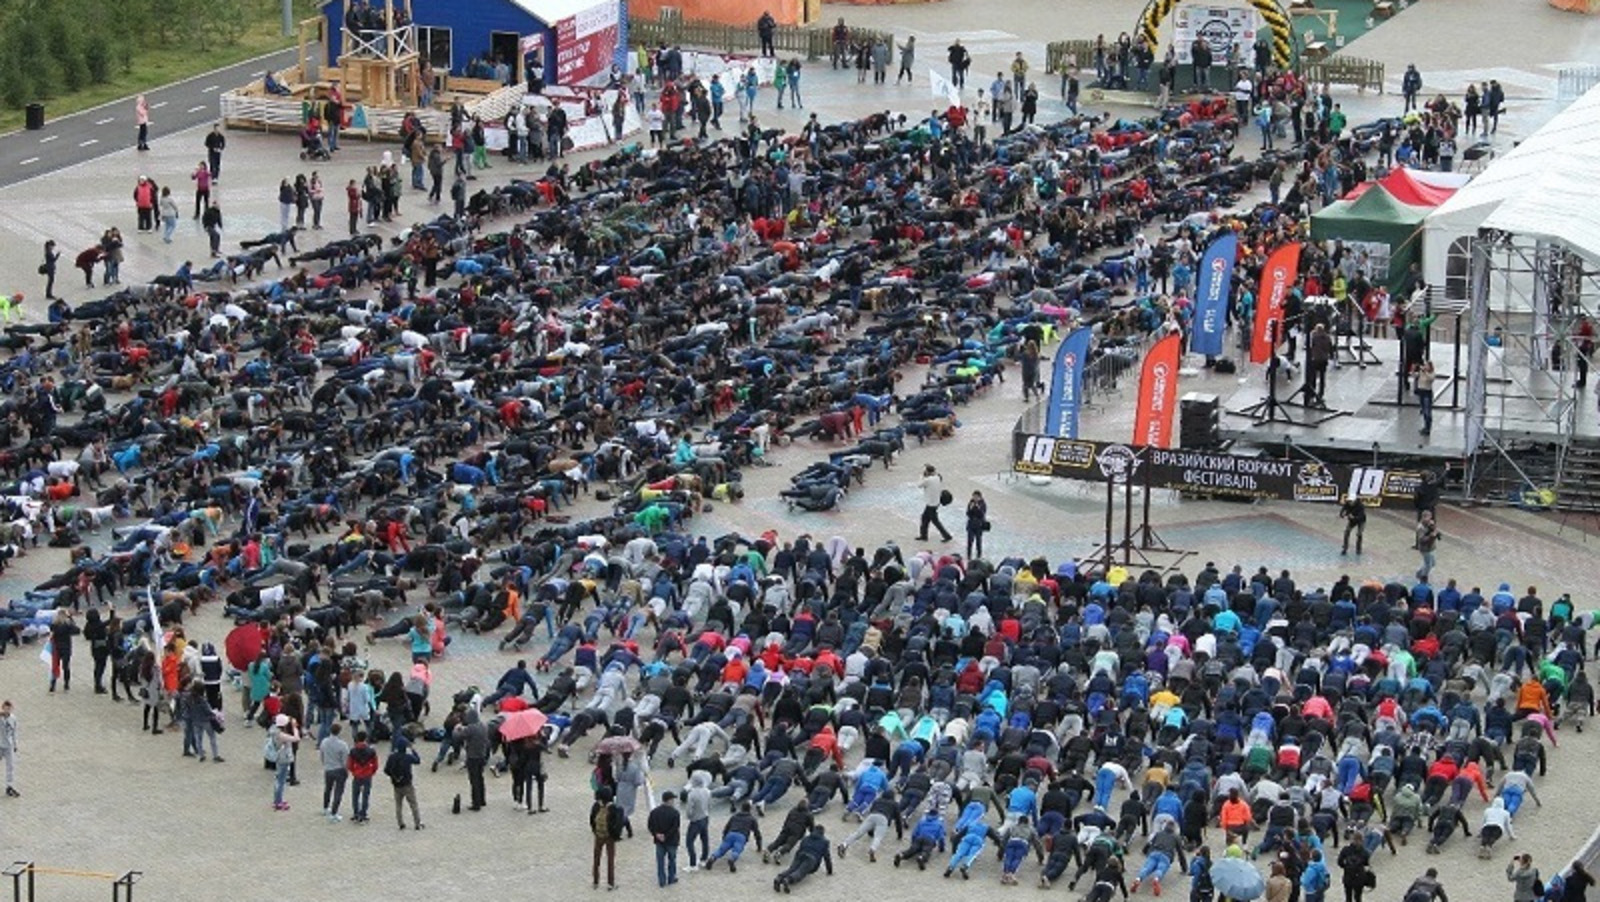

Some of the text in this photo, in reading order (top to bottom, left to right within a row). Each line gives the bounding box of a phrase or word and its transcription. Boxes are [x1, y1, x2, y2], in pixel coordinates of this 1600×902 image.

[1023, 436, 1055, 464] 10
[1151, 452, 1235, 472] ВРАЗИЙСКИЙ
[1237, 459, 1293, 477] ВОРКАУТ
[1183, 469, 1258, 490] ФЕСТИВАЛЬ
